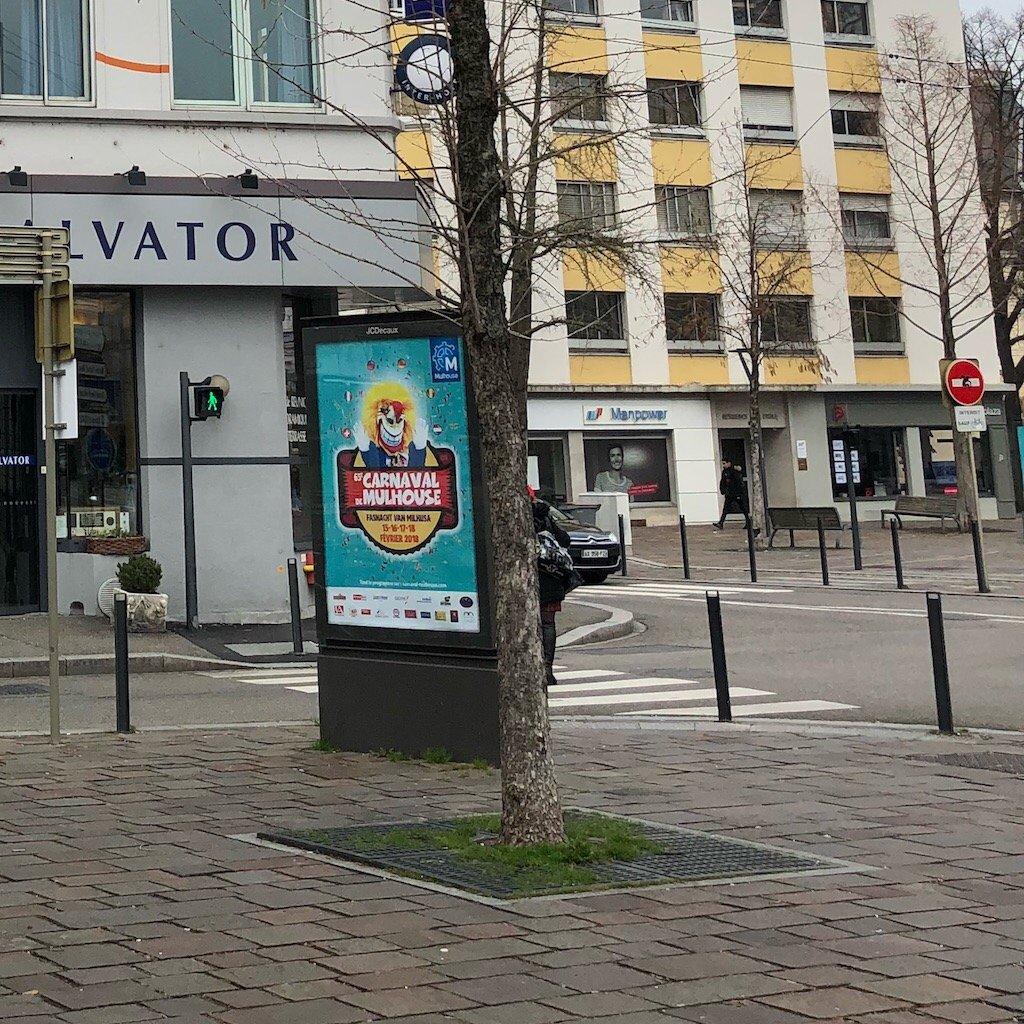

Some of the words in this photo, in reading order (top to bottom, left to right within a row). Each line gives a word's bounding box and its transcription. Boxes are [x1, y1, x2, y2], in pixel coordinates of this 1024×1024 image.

[366, 326, 399, 335] JCDecaux
[444, 356, 458, 372] M
[611, 407, 668, 422] Manpower
[362, 471, 440, 489] CARNAVAL
[362, 488, 442, 507] MULHOUSE
[394, 514, 406, 522] VAN
[404, 534, 419, 543] 2018
